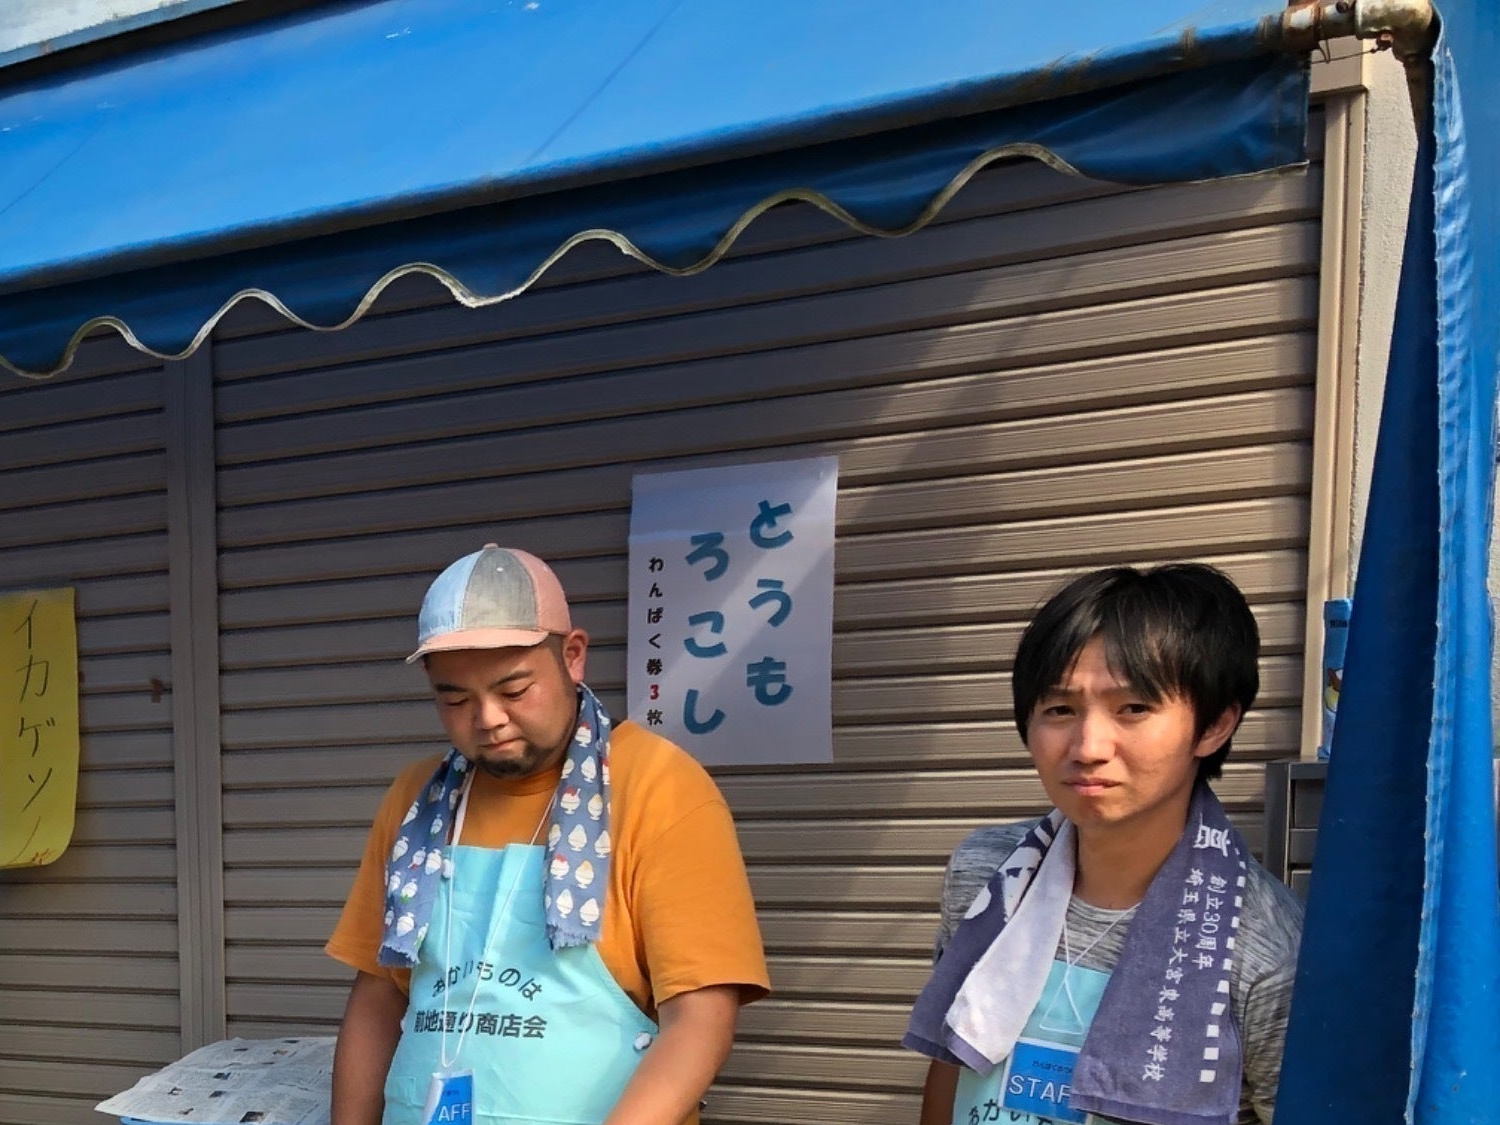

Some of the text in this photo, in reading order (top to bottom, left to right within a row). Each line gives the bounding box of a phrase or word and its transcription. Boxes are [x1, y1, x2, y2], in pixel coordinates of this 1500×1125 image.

[646, 556, 664, 726] わんぱく券3枚
[683, 532, 729, 735] ろこし
[746, 499, 794, 706] とうも
[1141, 868, 1205, 1082] 埼玉県立大宮東高等学校
[1192, 872, 1229, 970] 創立30周年
[413, 1009, 547, 1039] 前地通り商店会
[1008, 1075, 1071, 1104] STAF
[437, 1102, 471, 1123] AFF
